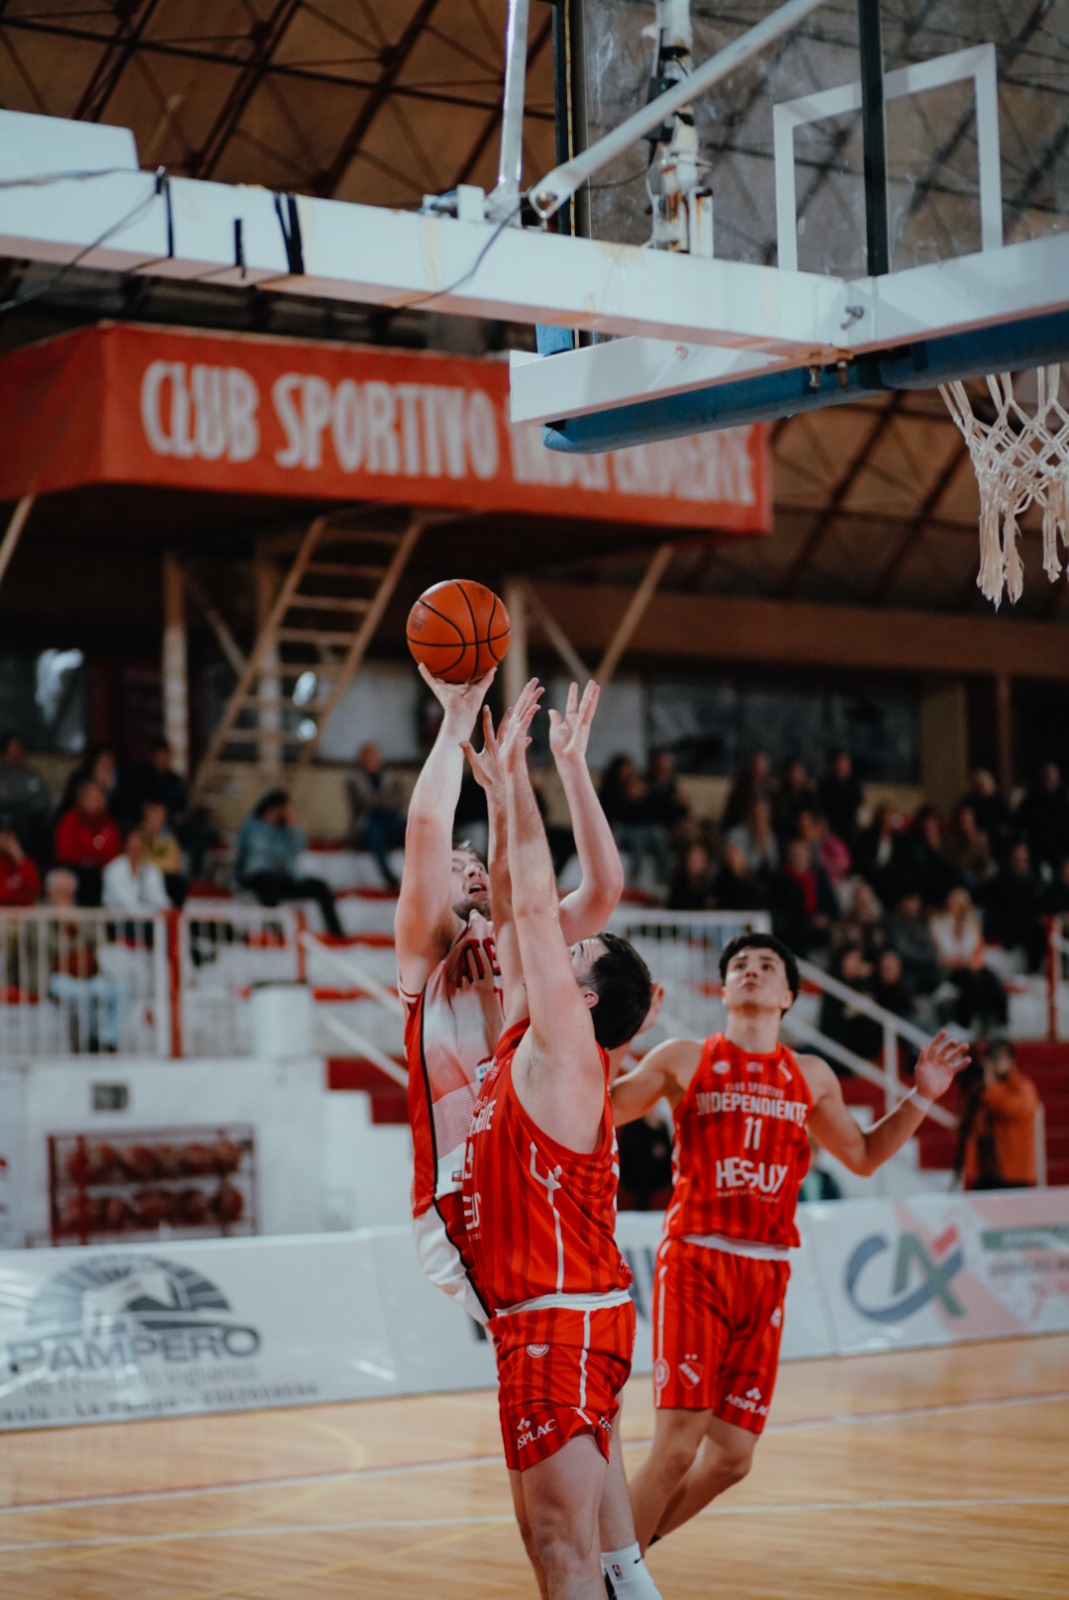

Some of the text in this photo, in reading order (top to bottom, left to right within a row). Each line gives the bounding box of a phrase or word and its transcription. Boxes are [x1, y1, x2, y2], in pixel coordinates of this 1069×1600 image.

[141, 360, 260, 462] CLUB
[272, 373, 498, 480] SPORTIVO
[695, 1091, 809, 1127] INDEPENDIENTE
[743, 1116, 763, 1151] 11
[6, 1325, 261, 1375] PAMPERO
